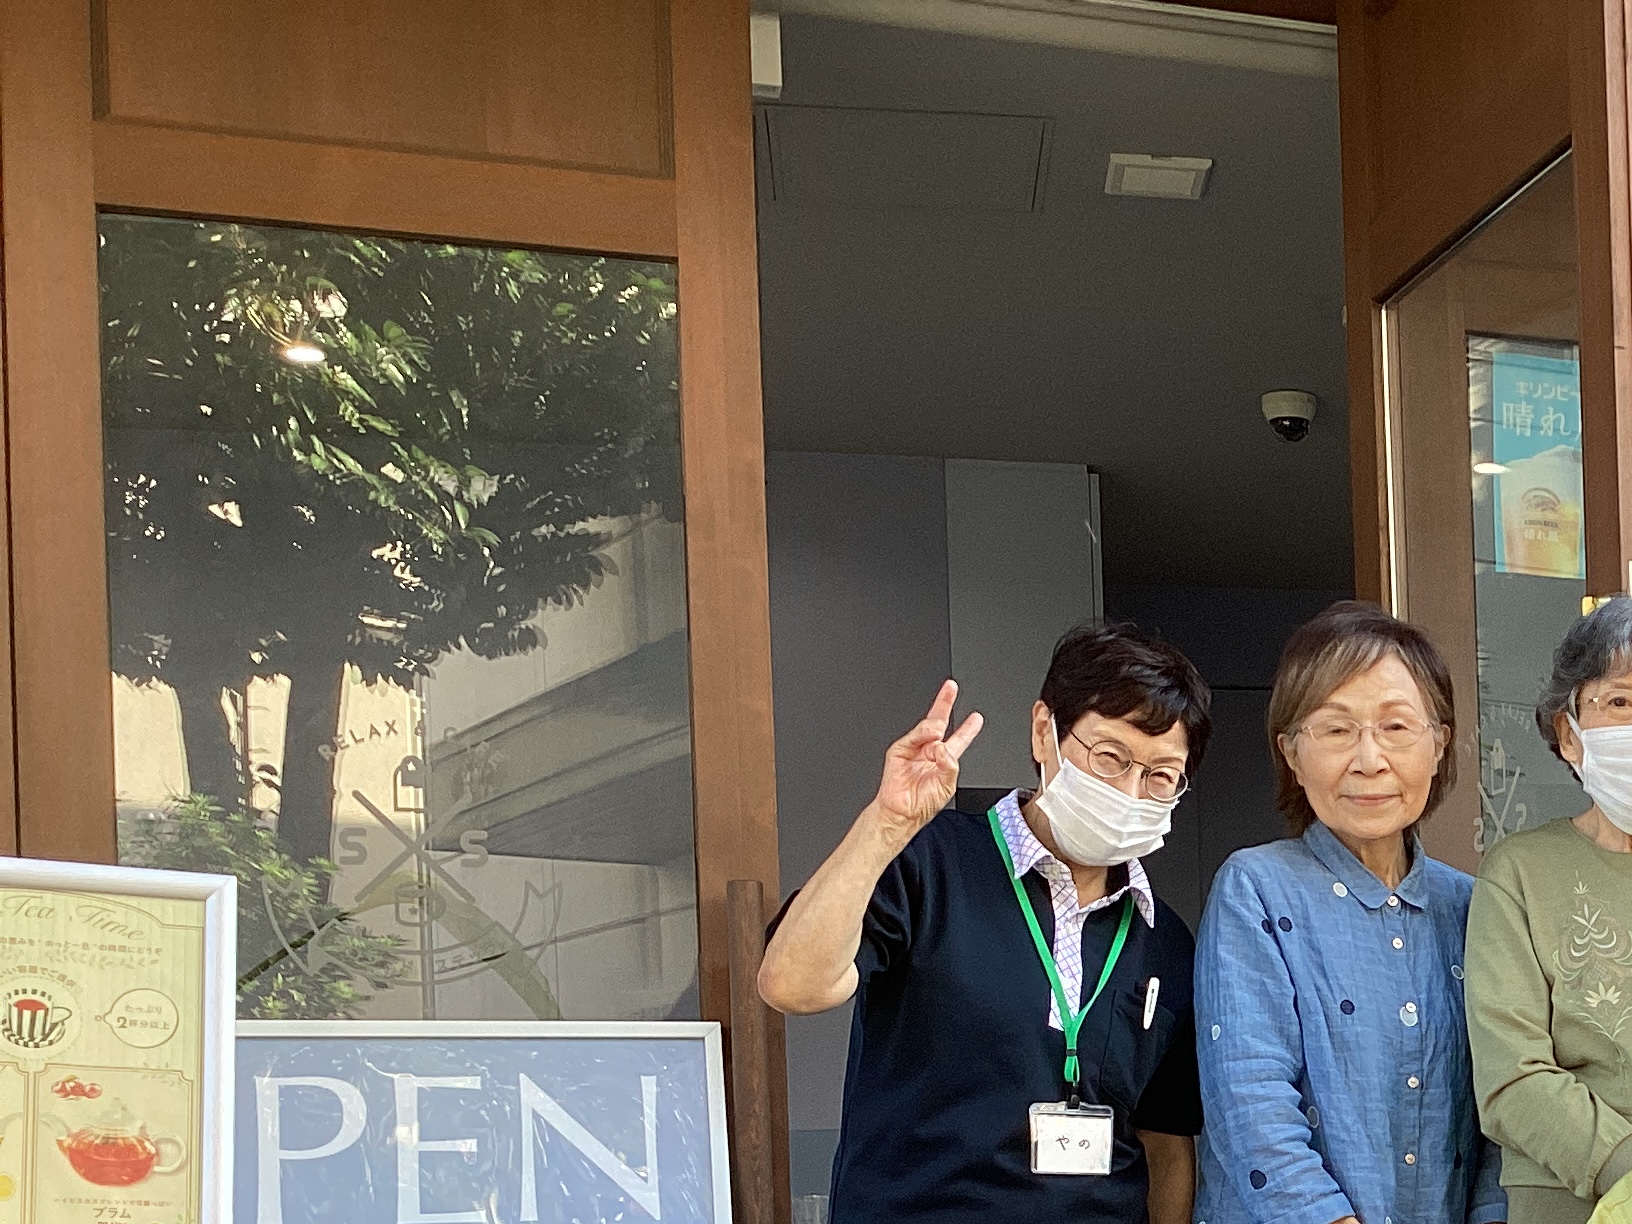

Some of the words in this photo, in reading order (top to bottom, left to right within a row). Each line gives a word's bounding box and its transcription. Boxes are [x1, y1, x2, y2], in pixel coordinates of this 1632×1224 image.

[1503, 401, 1580, 442] 晴れ
[318, 719, 398, 761] RELAX
[2, 895, 55, 919] Tea
[75, 904, 146, 940] Time
[1055, 1135, 1091, 1151] やの
[93, 1206, 131, 1219] プラム
